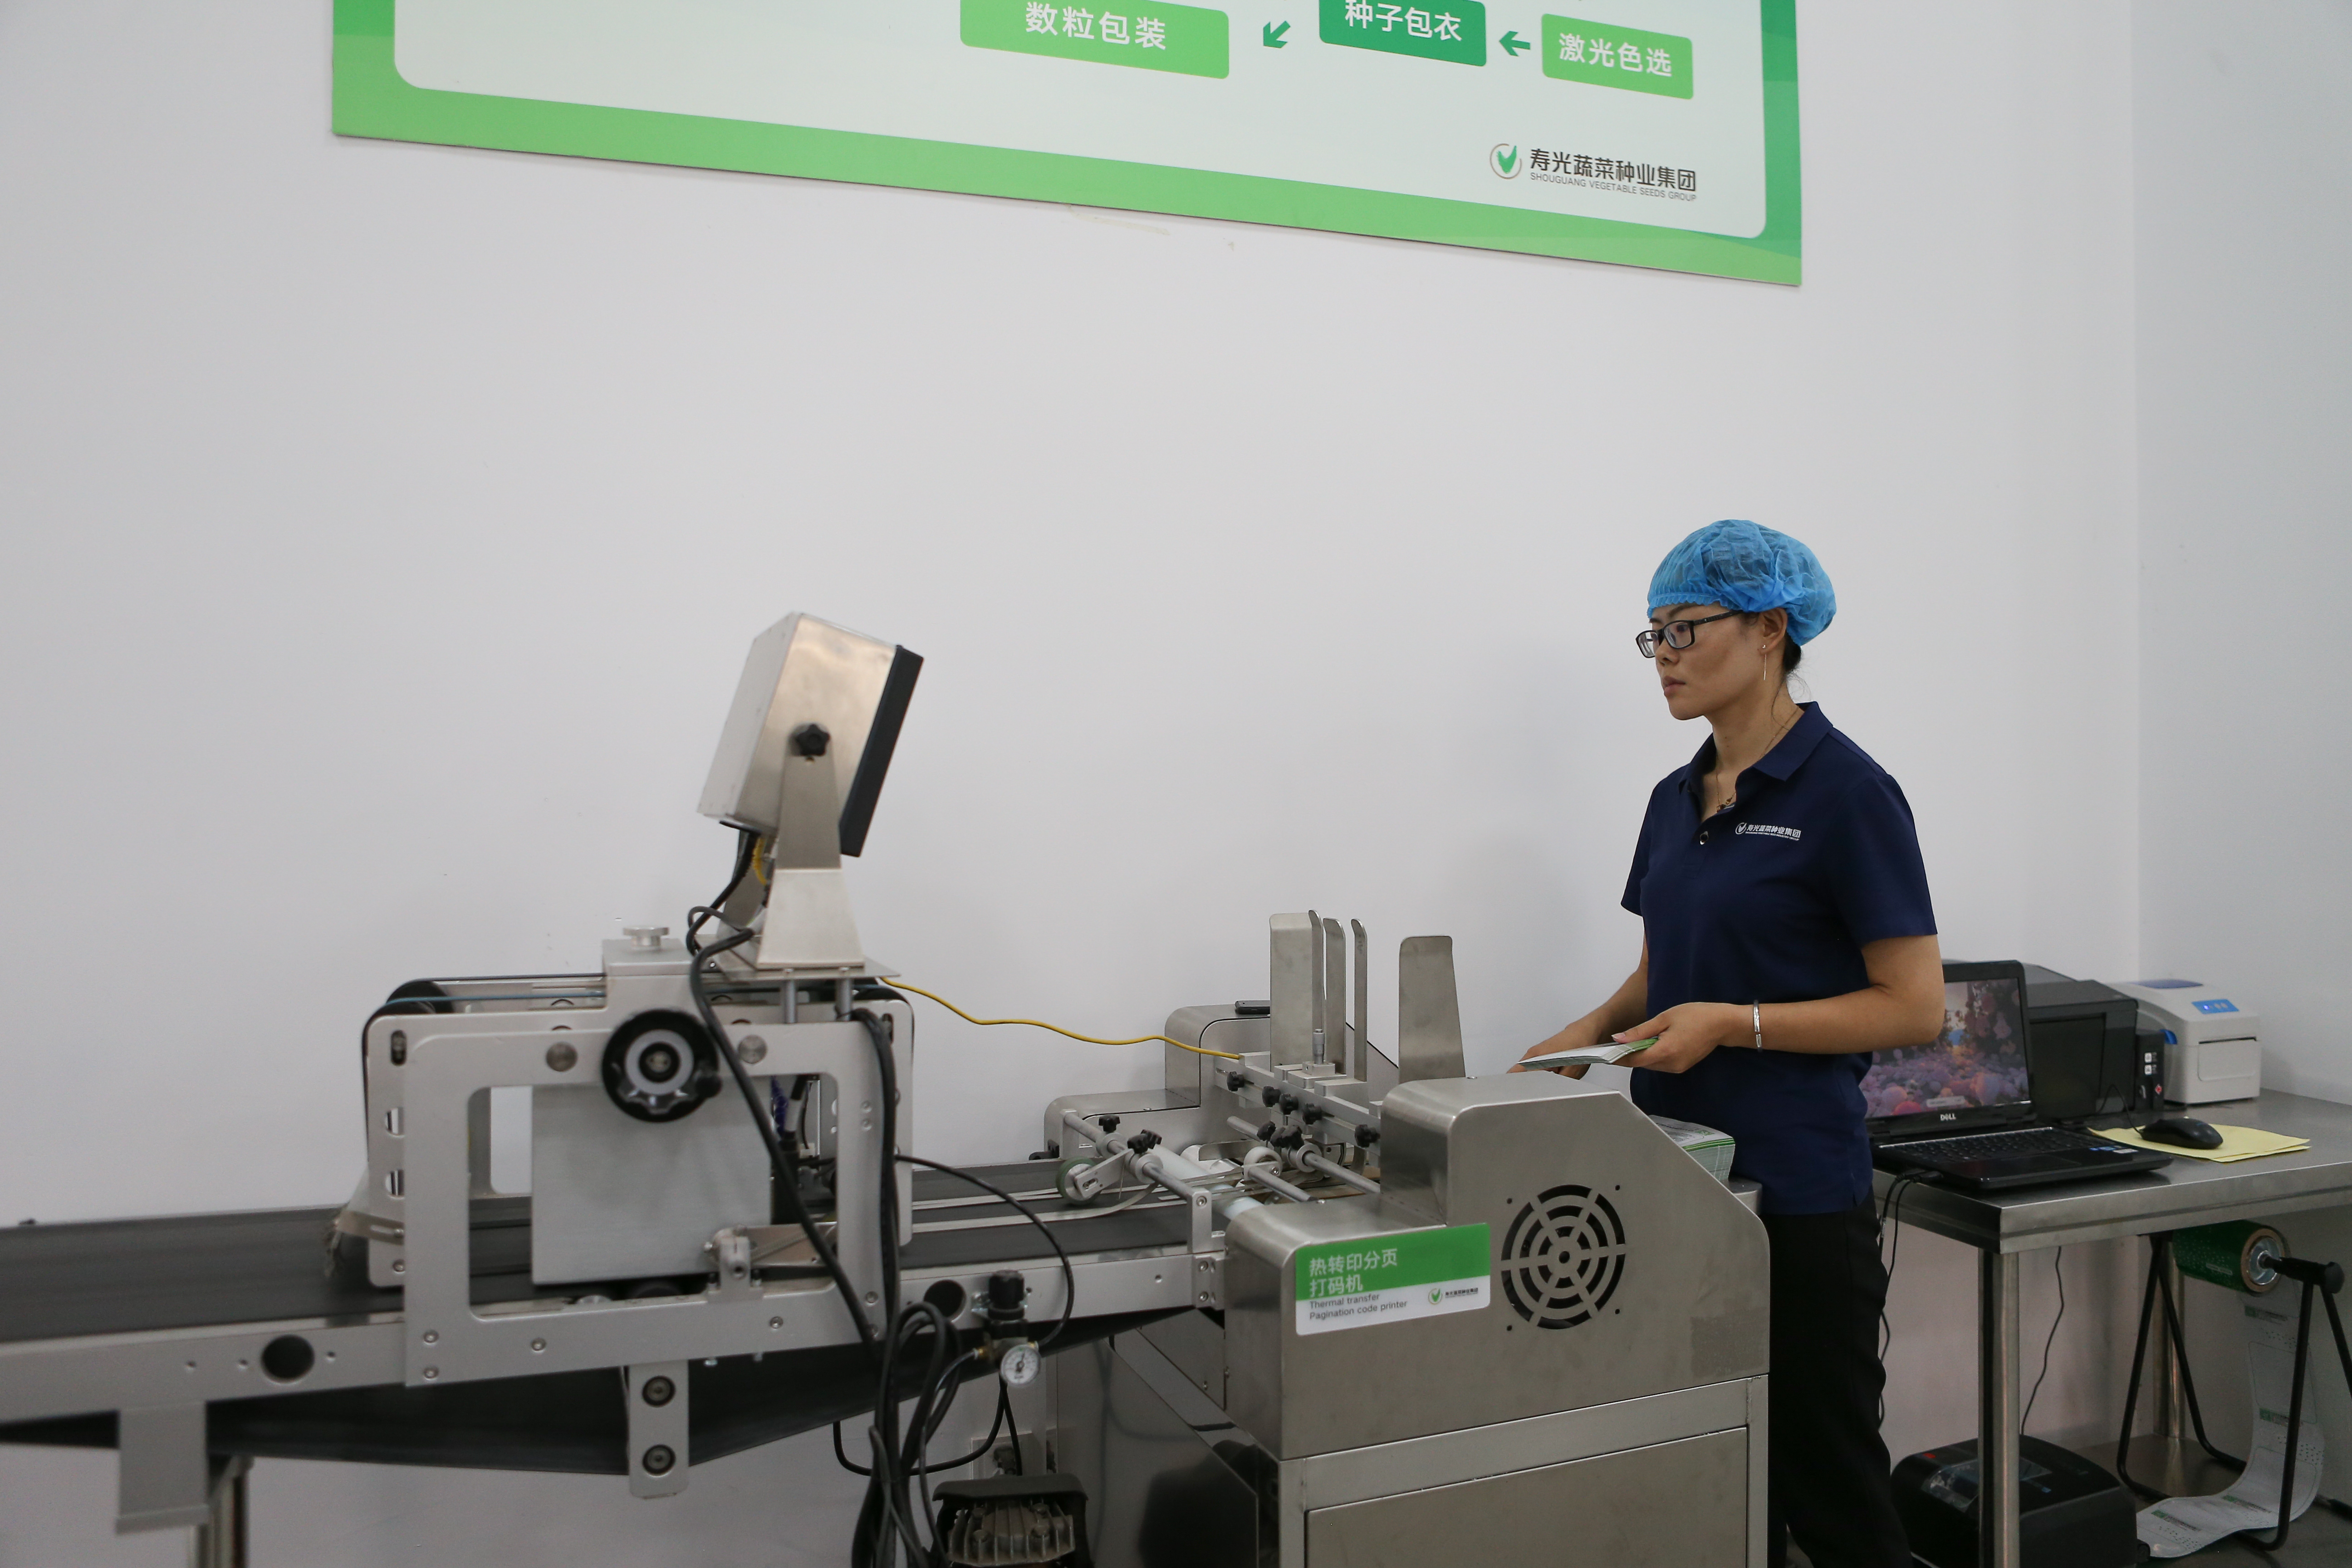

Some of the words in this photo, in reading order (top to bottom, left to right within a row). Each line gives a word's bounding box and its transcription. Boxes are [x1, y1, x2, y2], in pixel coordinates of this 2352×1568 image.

[1025, 1, 1166, 50] 数粒包装
[1344, 0, 1463, 41] 种子包衣
[1558, 32, 1672, 77] 激光色选
[1530, 148, 1696, 192] 寿光蔬菜种业集团
[1530, 172, 1587, 187] SHOUGUANG
[1589, 181, 1637, 194] VEGETABLE
[1639, 186, 1666, 198] SEEDS
[1667, 191, 1697, 202] GROUP
[1940, 1113, 1956, 1121] DELL
[1309, 1248, 1397, 1277] 热转印分页
[1309, 1274, 1363, 1298] 打码机
[1309, 1298, 1344, 1309] Thermal
[1347, 1293, 1380, 1304] transfer
[1309, 1307, 1354, 1320] Pagination
[1357, 1304, 1378, 1314] code
[1380, 1300, 1408, 1312] printer
